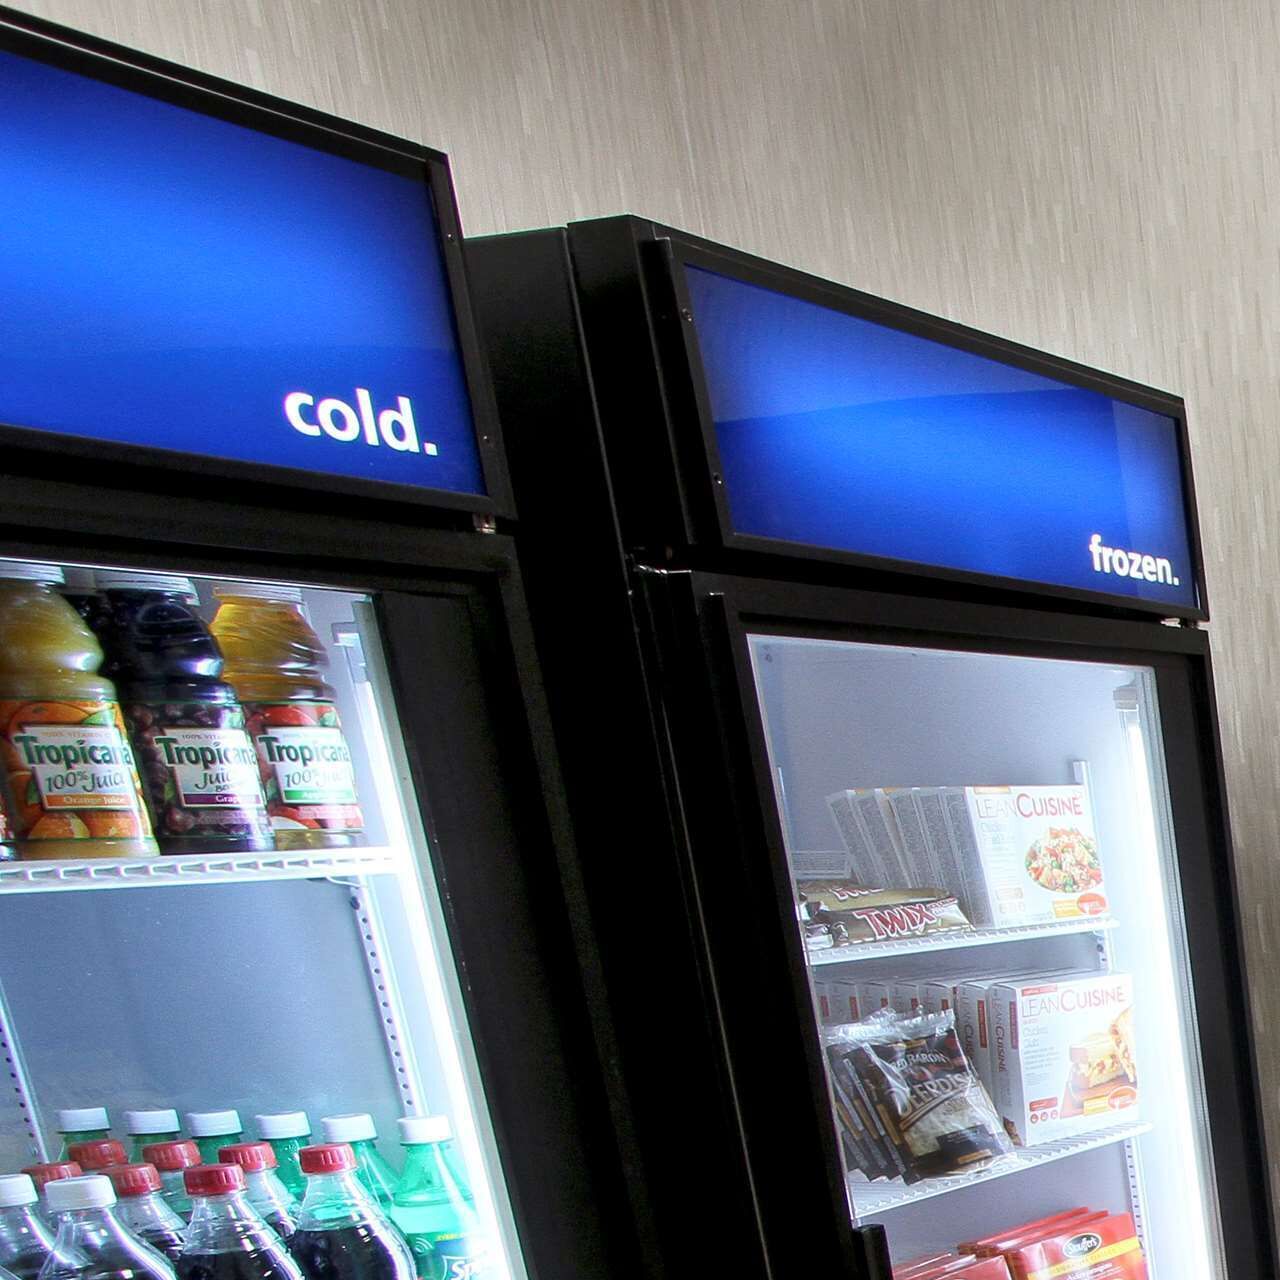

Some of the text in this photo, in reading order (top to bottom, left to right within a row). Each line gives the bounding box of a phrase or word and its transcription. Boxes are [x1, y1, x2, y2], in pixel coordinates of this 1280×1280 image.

[284, 388, 439, 457] cold.
[1089, 534, 1180, 587] frozen.
[1016, 792, 1084, 819] CUISINE
[852, 900, 936, 939] TWIX
[1060, 985, 1128, 1012] CUISINE
[1067, 1234, 1101, 1256] Stouffer's
